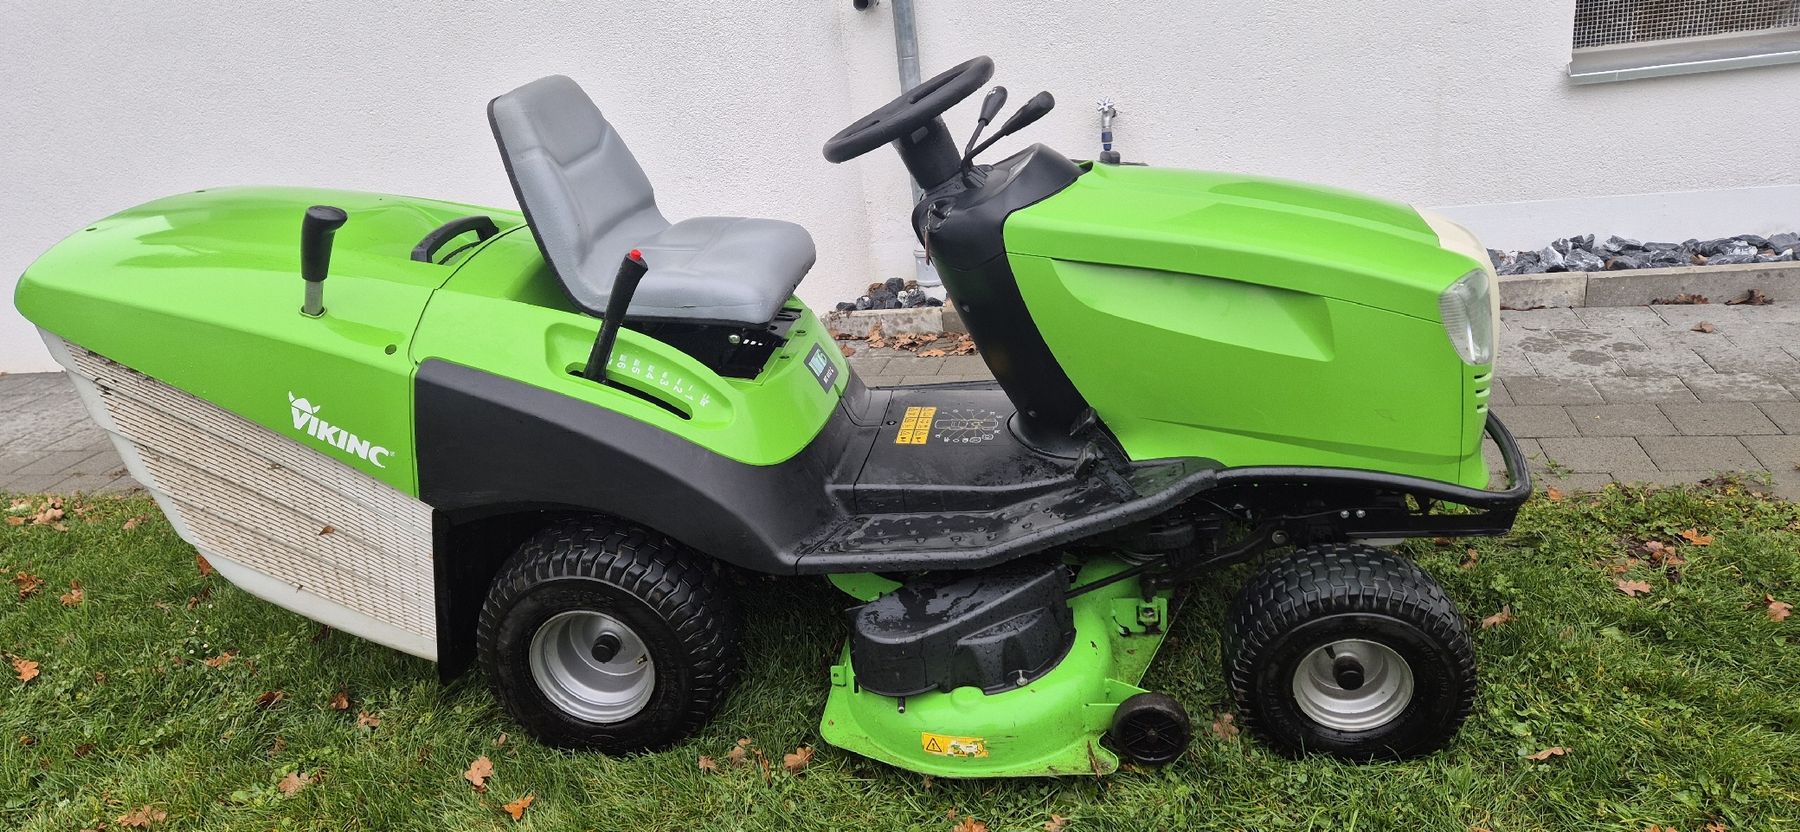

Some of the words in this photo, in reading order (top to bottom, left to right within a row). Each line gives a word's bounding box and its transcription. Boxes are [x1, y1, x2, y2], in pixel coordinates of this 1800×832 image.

[616, 361, 626, 370] 6
[631, 366, 640, 375] 5
[646, 372, 655, 380] 4
[660, 378, 669, 386] 3
[673, 385, 683, 393] 2
